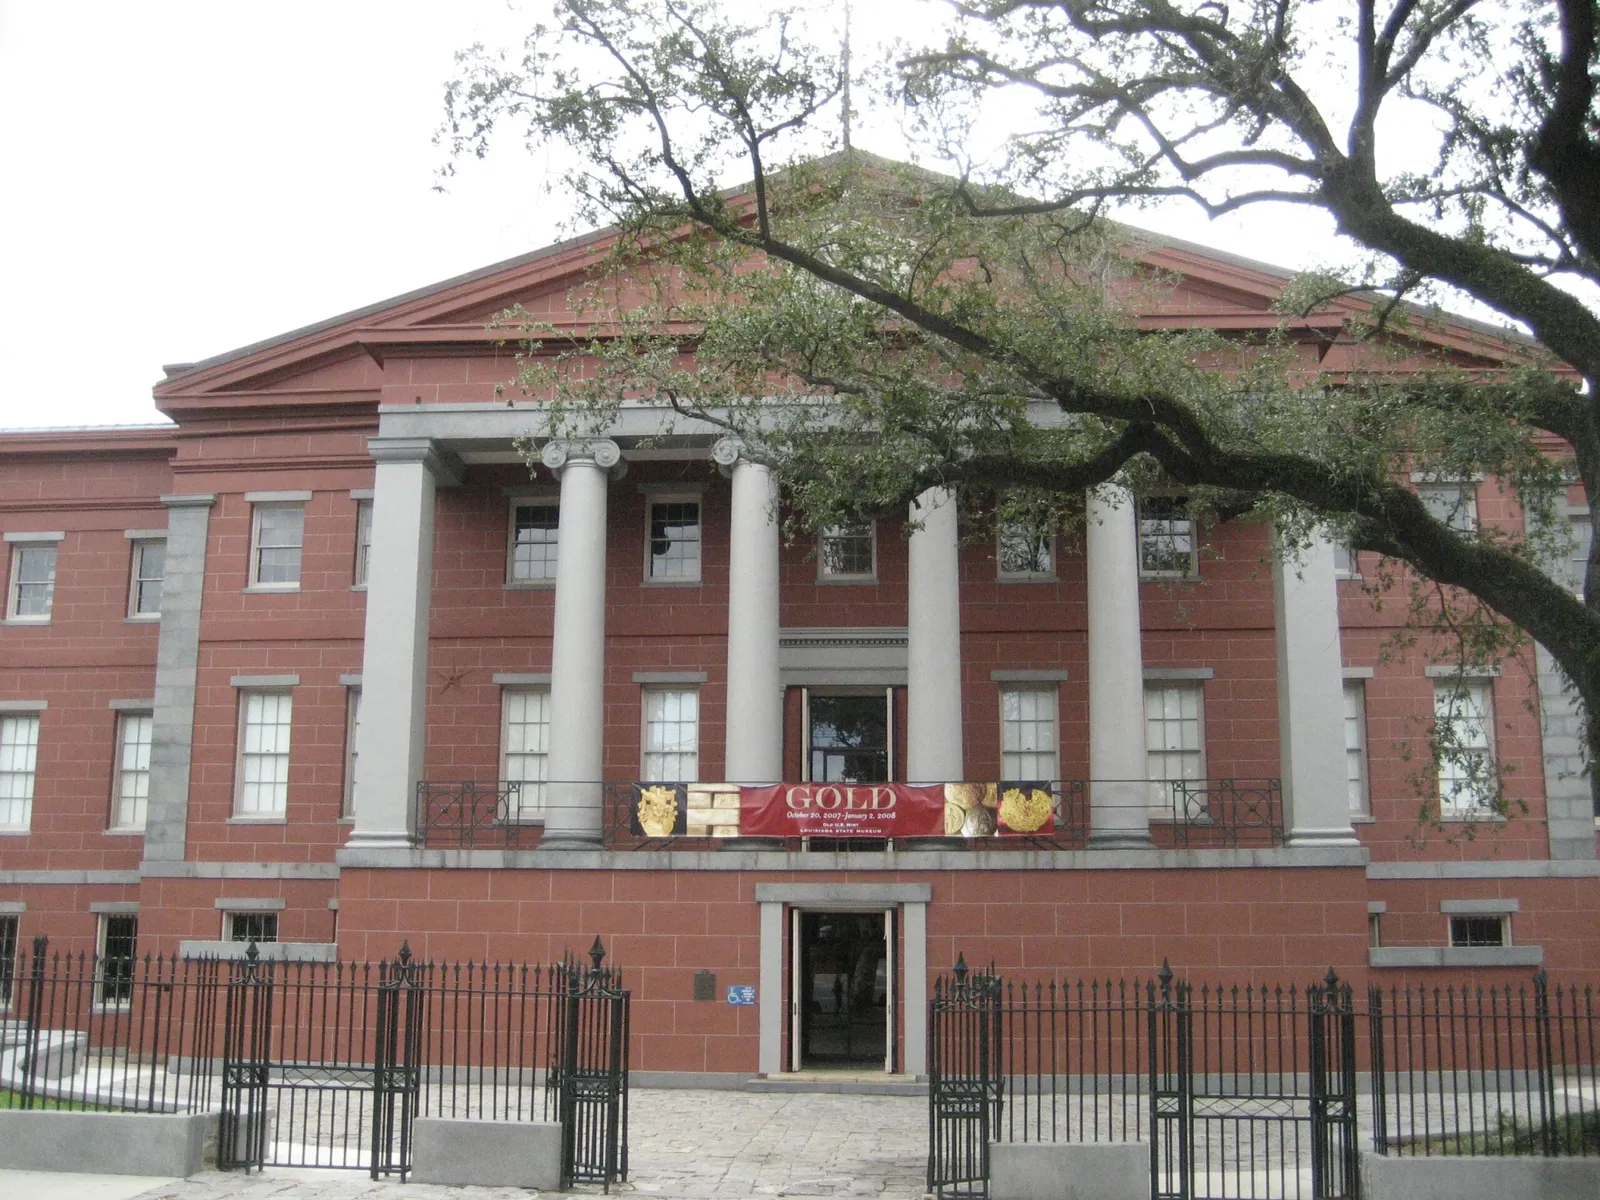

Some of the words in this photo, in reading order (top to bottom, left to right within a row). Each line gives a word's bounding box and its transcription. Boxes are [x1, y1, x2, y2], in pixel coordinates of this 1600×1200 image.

[786, 786, 897, 810] GOLD
[787, 811, 809, 819] October
[877, 811, 896, 819] 2008
